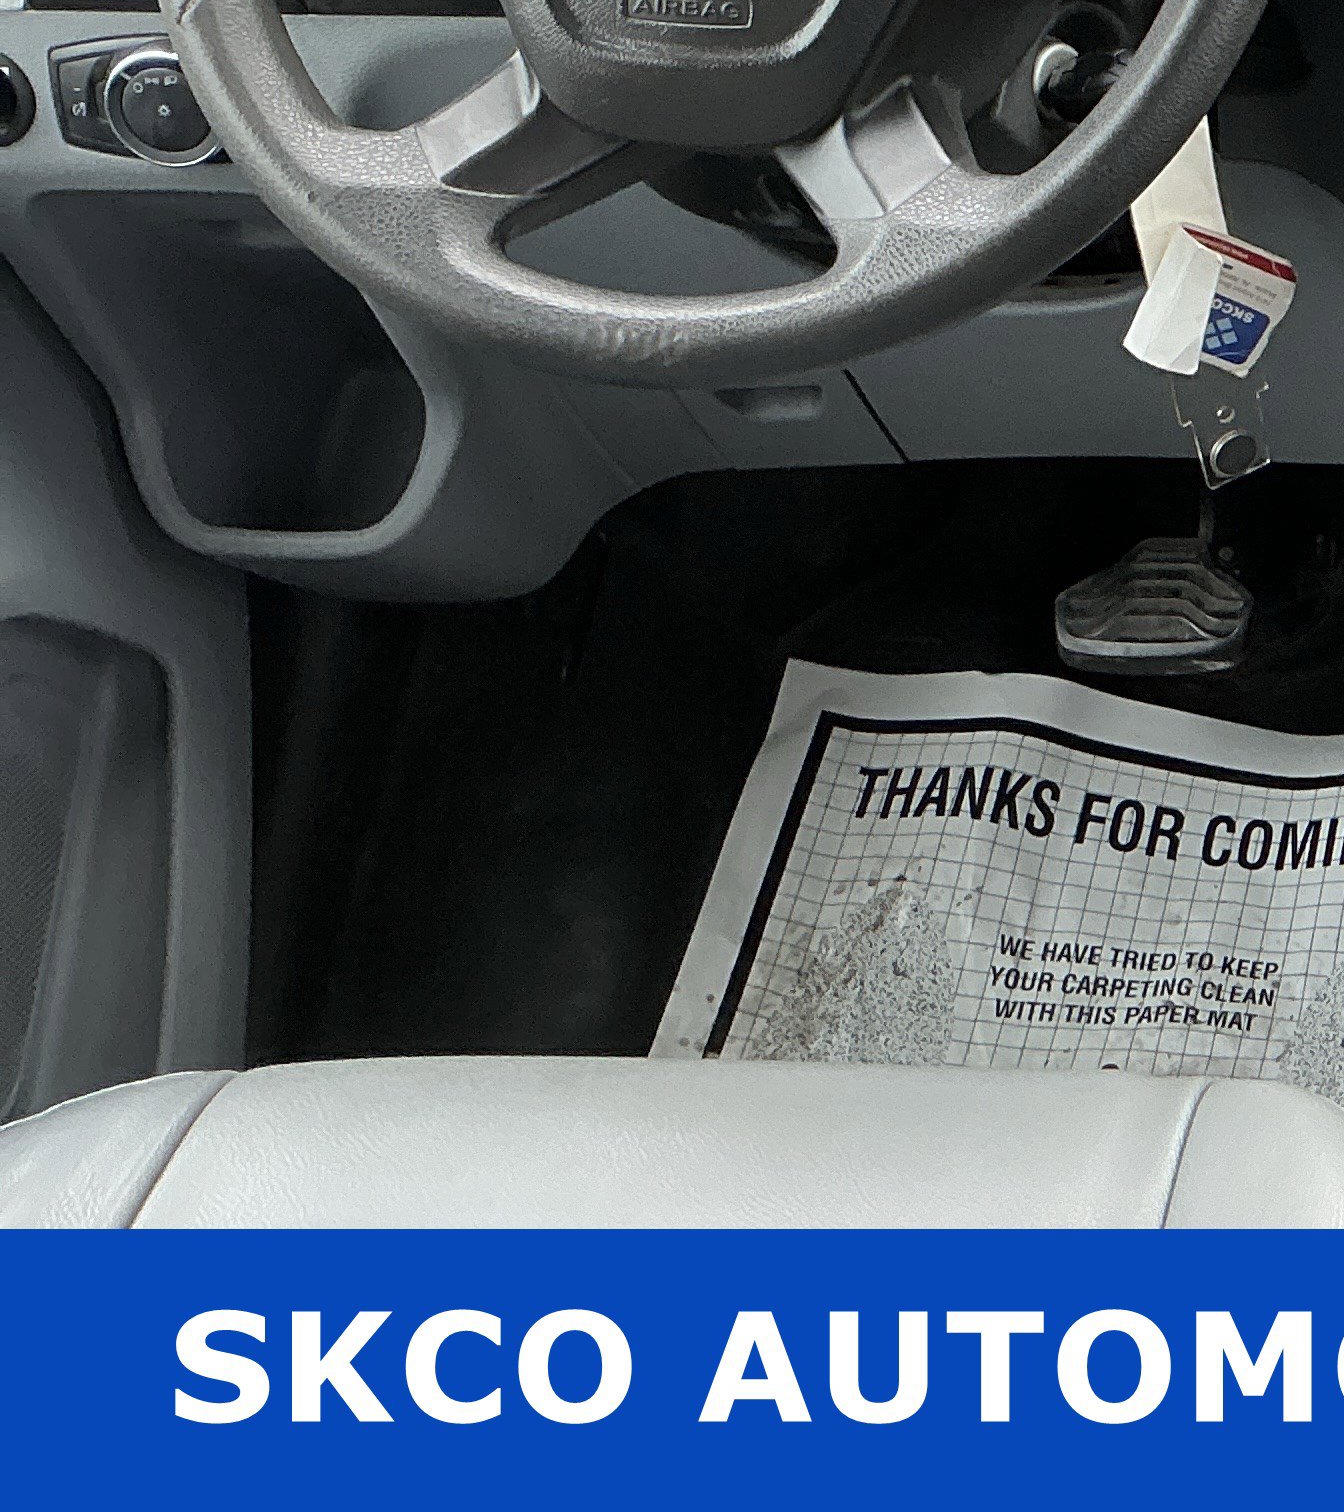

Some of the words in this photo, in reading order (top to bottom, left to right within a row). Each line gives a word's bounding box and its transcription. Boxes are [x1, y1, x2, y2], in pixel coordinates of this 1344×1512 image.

[853, 766, 1060, 838] THANKS
[1072, 794, 1185, 860] FOR
[999, 934, 1036, 960] WE
[1040, 940, 1102, 966] HAVE
[1109, 947, 1177, 972] TRIED
[1184, 951, 1214, 972] TO
[1219, 955, 1280, 980] KEEP
[989, 965, 1053, 993] YOUR
[1060, 973, 1194, 999] CARPETING
[1199, 980, 1276, 1007] CLEAN
[994, 997, 1056, 1022] WITH
[1063, 1003, 1117, 1025] THIS
[1122, 1004, 1200, 1025] PAPER
[1205, 1009, 1259, 1032] MAT
